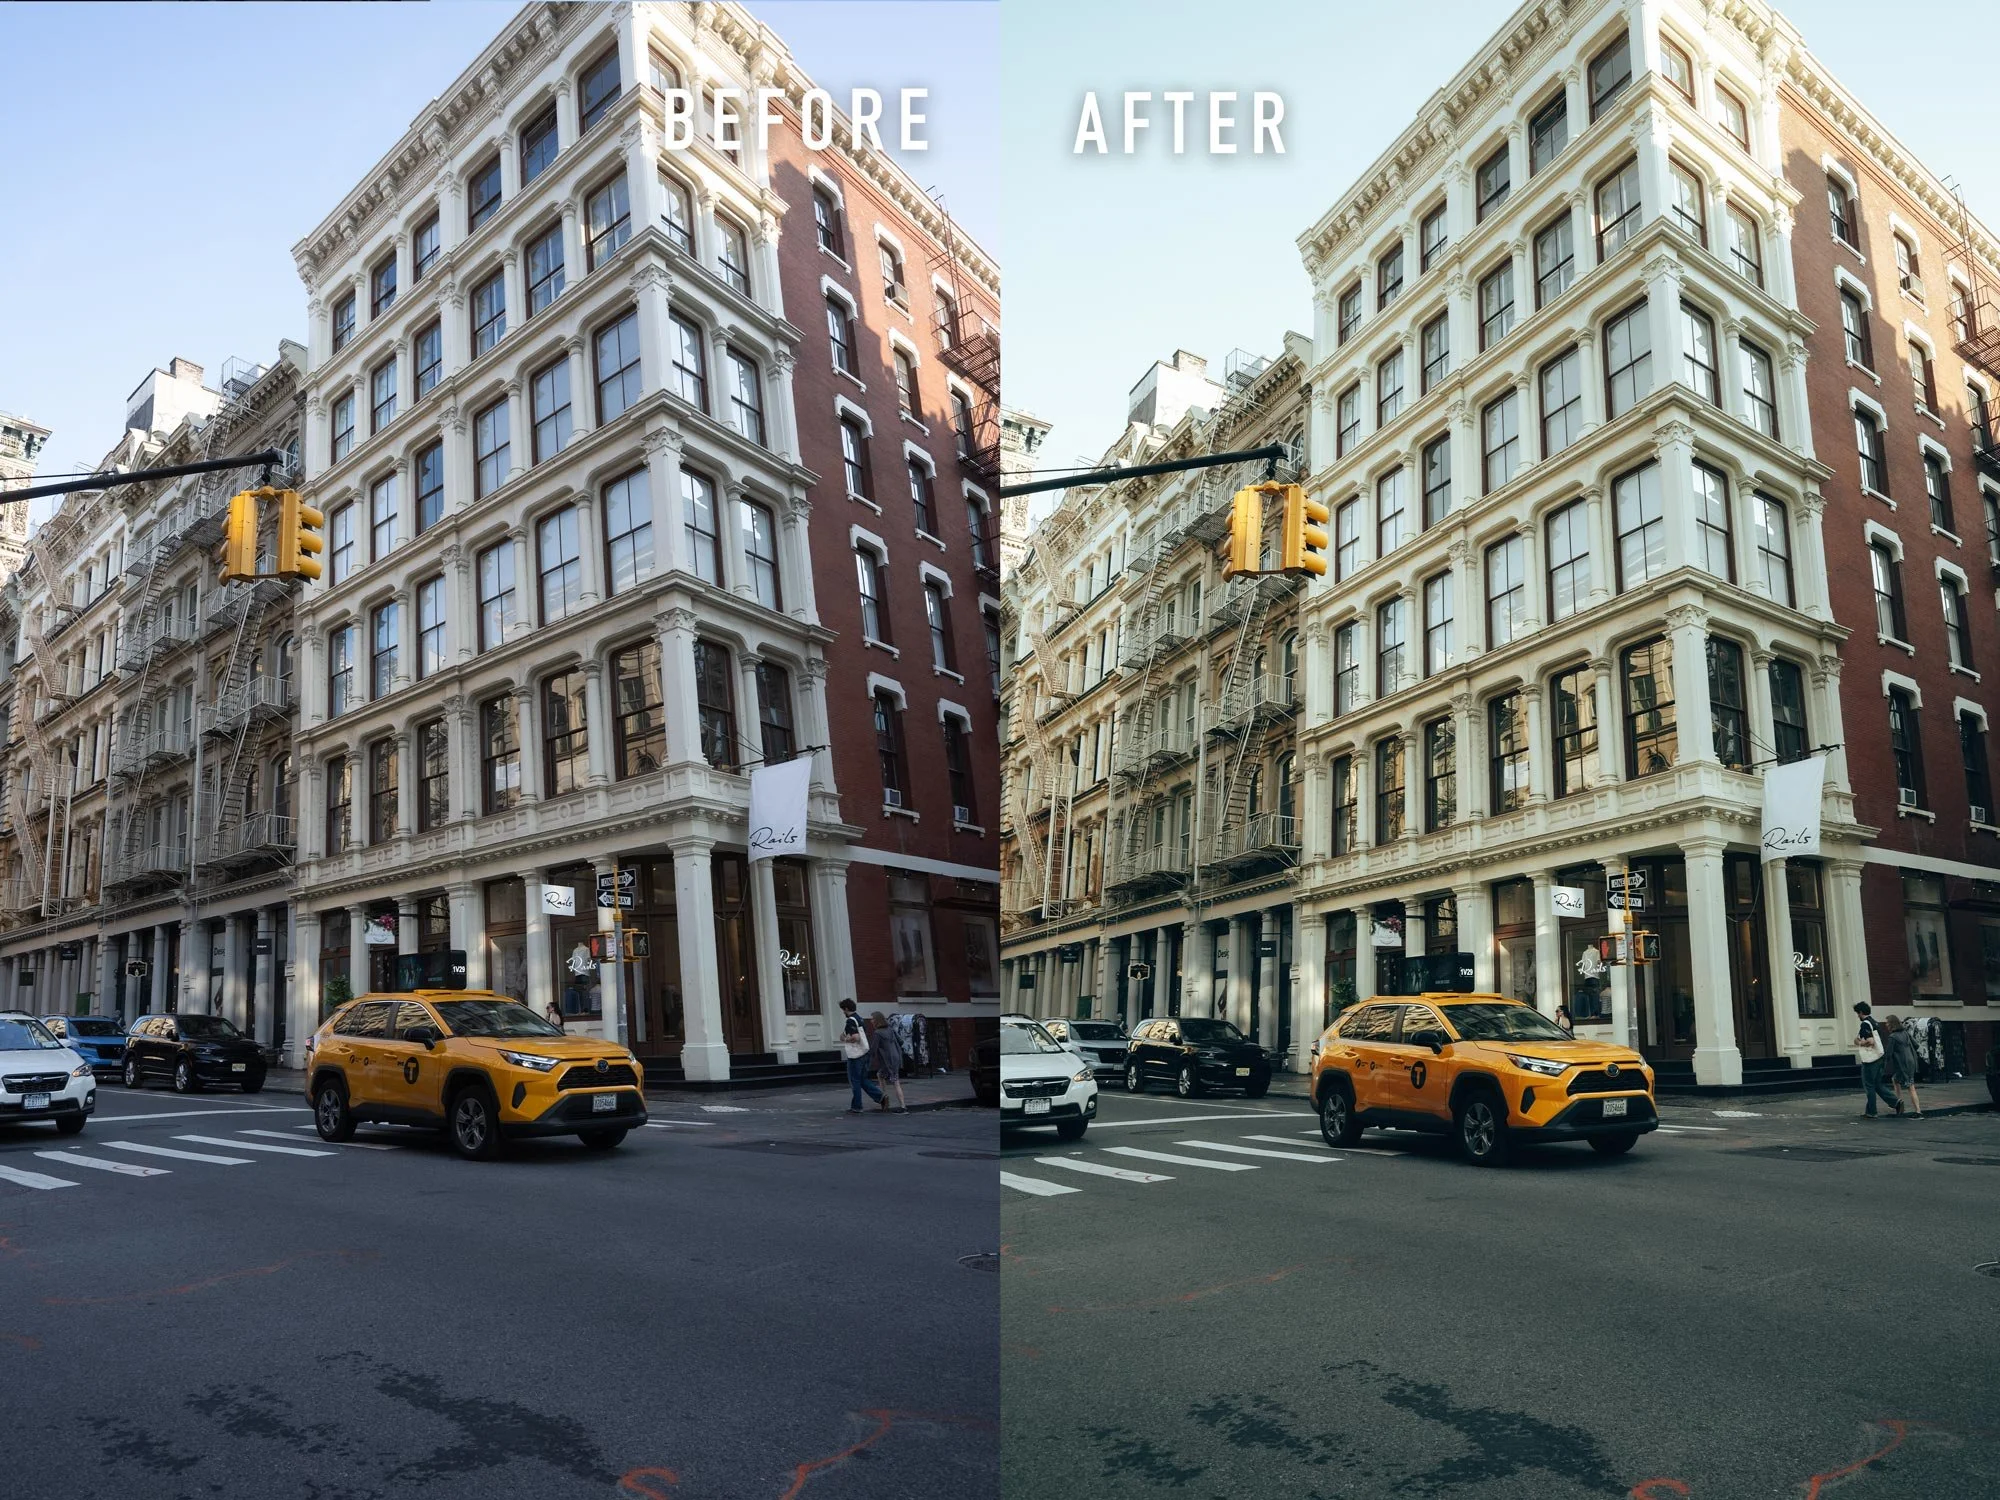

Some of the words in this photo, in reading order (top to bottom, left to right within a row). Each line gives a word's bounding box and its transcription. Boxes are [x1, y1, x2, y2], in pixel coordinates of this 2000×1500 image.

[749, 826, 798, 850] Rails
[1762, 827, 1812, 850] Rails
[603, 877, 615, 886] ONE
[1613, 878, 1625, 887] ONE
[544, 891, 573, 909] Rails
[602, 895, 615, 904] ONE
[1554, 892, 1583, 910] Rails
[1613, 896, 1625, 905] ONE
[566, 955, 597, 974] Rails
[780, 949, 801, 968] Rails
[1793, 952, 1815, 971] Rails
[453, 965, 466, 973] 1V29
[1460, 968, 1474, 976] 1V29
[1575, 958, 1607, 979] Rails
